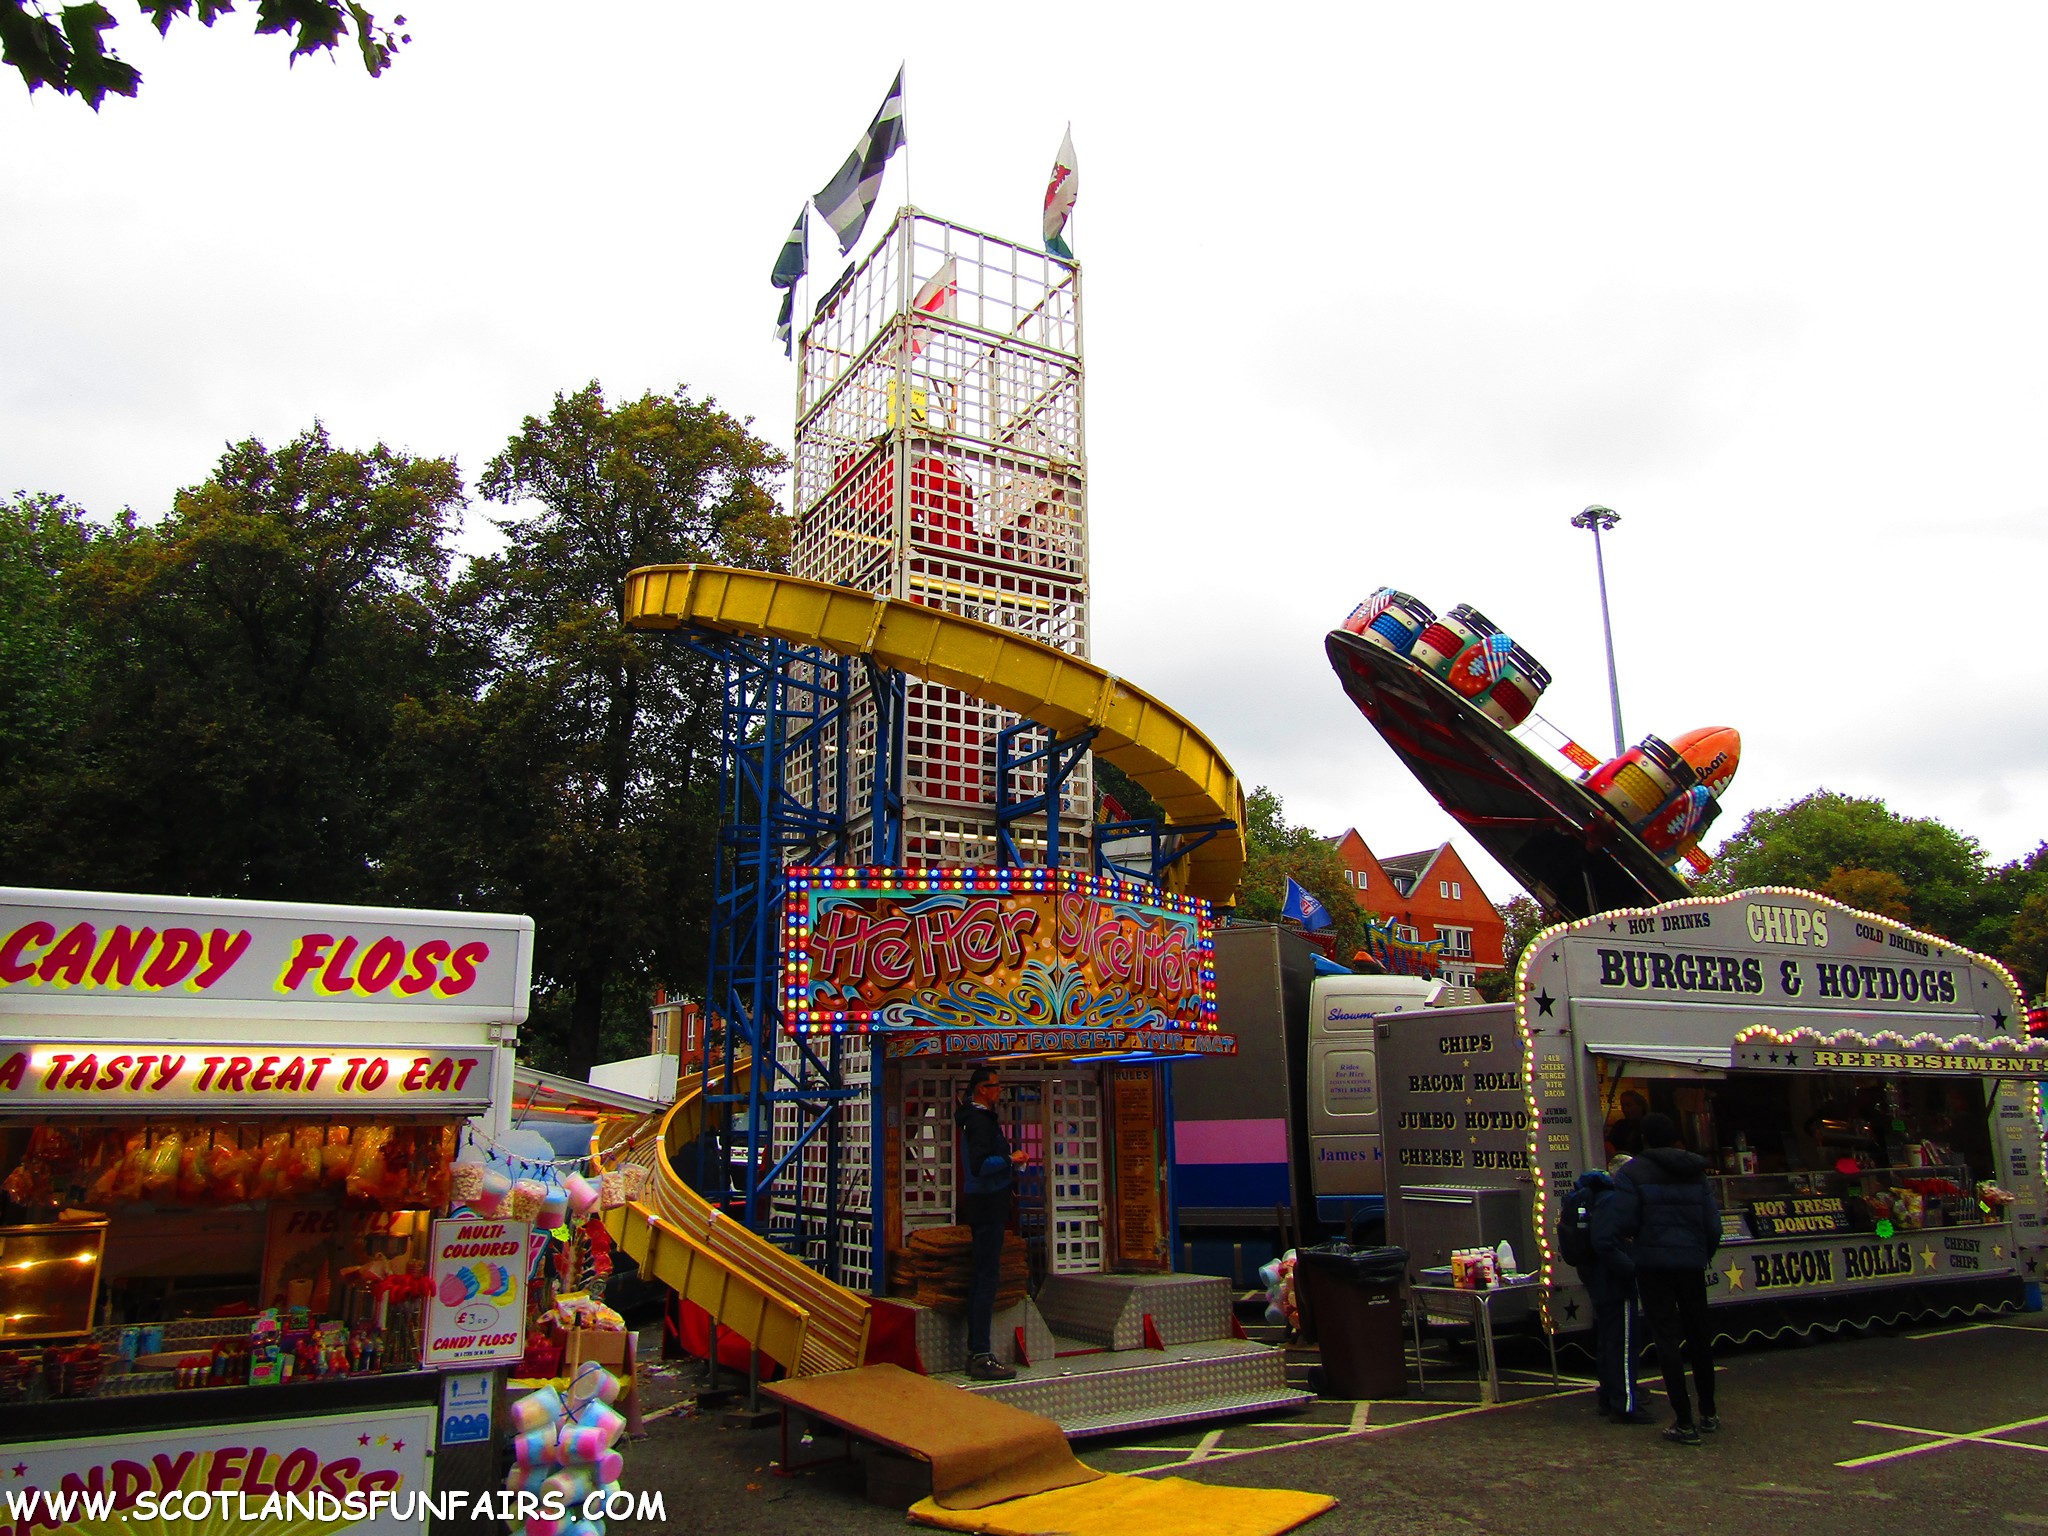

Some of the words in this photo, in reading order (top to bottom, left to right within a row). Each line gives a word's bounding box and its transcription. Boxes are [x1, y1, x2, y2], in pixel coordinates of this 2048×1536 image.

[1628, 917, 1655, 934] HOT
[1662, 912, 1711, 932] DRINKS
[1746, 903, 1829, 948] CHIPS
[810, 897, 1038, 982] Helter
[1055, 891, 1201, 993] Skelter
[1856, 923, 1883, 944] COLD
[1889, 932, 1929, 957] DRINKS
[0, 921, 251, 991] CANDY
[273, 934, 489, 998] FLOSS
[1598, 948, 1764, 996] BURGERS
[1780, 960, 1803, 997] &
[1816, 963, 1957, 1004] HOTDOGS
[1028, 1031, 1125, 1050] FORGET
[1136, 1031, 1184, 1051] YOUR
[1195, 1035, 1235, 1053] MAT
[1439, 1034, 1493, 1055] CHIPS
[1813, 1050, 2048, 1072] REFRESHMENT
[0, 1052, 31, 1090] A
[45, 1054, 186, 1093] TASTY
[197, 1056, 332, 1093] TREAT
[341, 1057, 389, 1092] TO
[400, 1058, 478, 1092] EAT
[1115, 1070, 1149, 1081] RULES
[1409, 1073, 1466, 1093] BACON
[1473, 1072, 1523, 1091] ROLL
[1398, 1111, 1457, 1130] JUMBO
[1464, 1111, 1531, 1130] HOTDO
[1545, 1107, 1567, 1115] JUMBO
[1548, 1134, 1569, 1142] BACON
[1318, 1147, 1366, 1161] James
[1400, 1148, 1465, 1168] CHEESE
[1472, 1150, 1530, 1170] BURGE
[1554, 1180, 1572, 1188] PORK
[1753, 1200, 1787, 1216] HOT
[1794, 1198, 1844, 1213] FRESH
[457, 1224, 506, 1240] MULTI-
[1772, 1215, 1837, 1233] DONUTS
[443, 1241, 519, 1259] COLOURED
[1944, 1237, 1981, 1253] CHEESY
[1751, 1248, 1833, 1290] BACON
[1842, 1241, 1914, 1281] ROLLS
[1950, 1254, 1979, 1269] CHIPS
[433, 1335, 476, 1351] CANDY
[478, 1333, 518, 1348] FLOSS
[0, 1451, 196, 1536] ANDY
[207, 1447, 400, 1511] FLOSS
